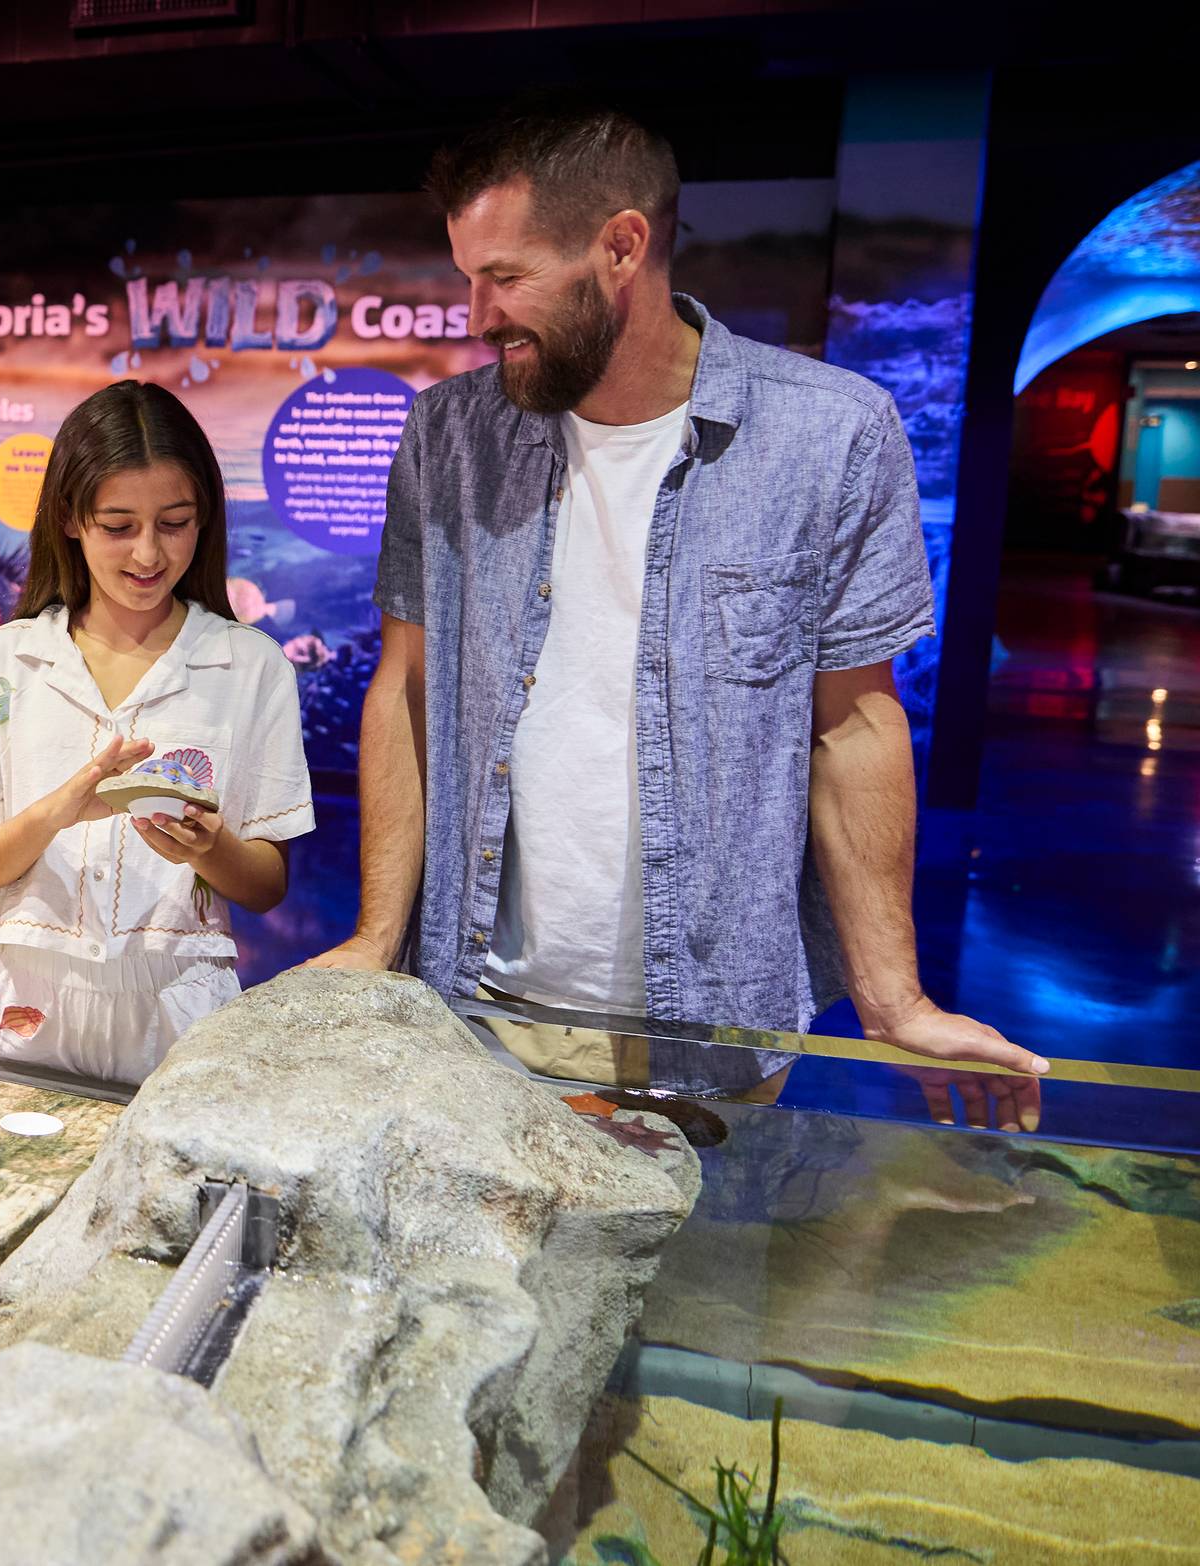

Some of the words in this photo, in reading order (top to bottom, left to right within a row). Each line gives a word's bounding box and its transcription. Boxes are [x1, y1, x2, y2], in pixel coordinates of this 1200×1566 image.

[126, 276, 338, 352] WILD
[351, 295, 469, 339] Coas
[305, 391, 325, 404] The
[325, 392, 373, 404] Southern
[373, 393, 406, 405] Ocean
[291, 407, 302, 418] is
[302, 408, 322, 419] one
[323, 407, 335, 419] of
[335, 407, 353, 420] the
[353, 409, 381, 420] most
[381, 408, 408, 422] uniq
[279, 423, 300, 434] and
[301, 423, 354, 436] productive
[273, 437, 304, 450] Earth,
[304, 438, 347, 452] teeming
[347, 439, 372, 450] with
[11, 446, 45, 458] Leave
[301, 453, 326, 466] cold,
